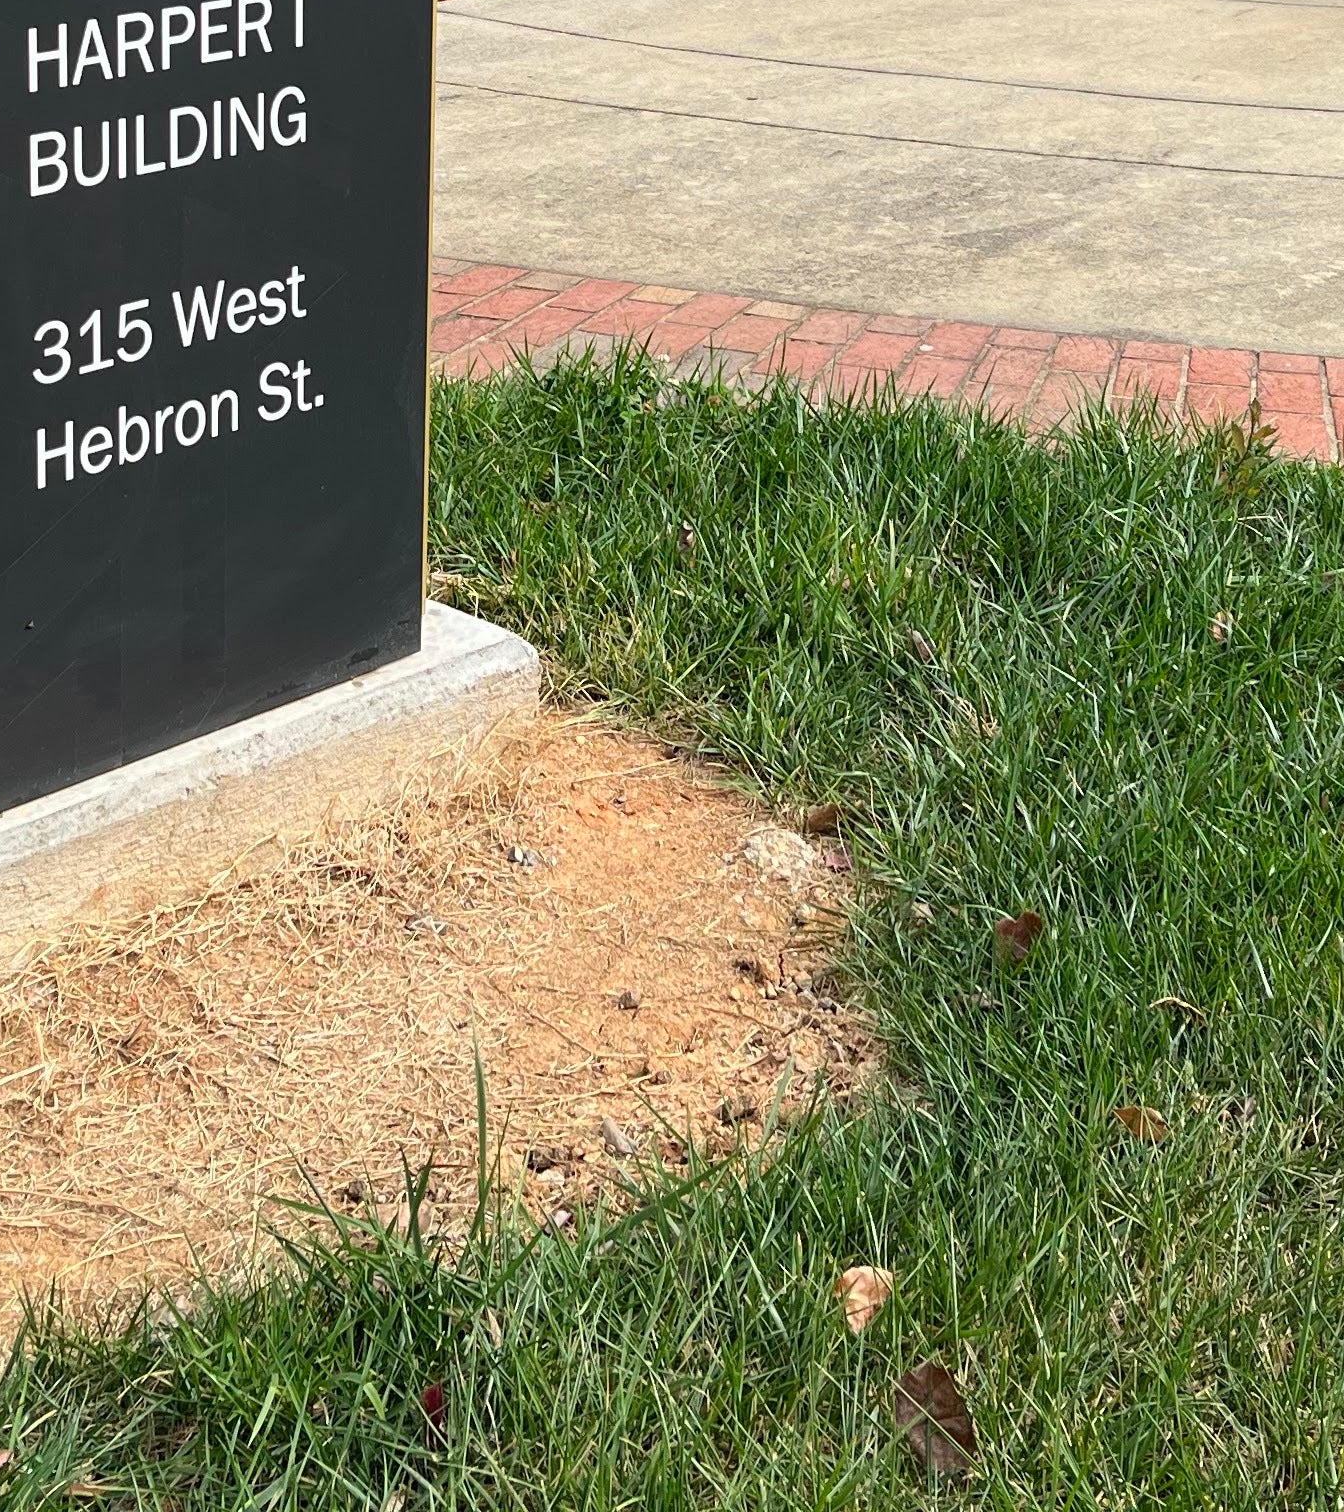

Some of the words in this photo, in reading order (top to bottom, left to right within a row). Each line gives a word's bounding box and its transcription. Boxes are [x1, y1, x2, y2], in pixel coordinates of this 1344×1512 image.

[29, 85, 308, 197] BUILDING
[32, 298, 153, 385] 315
[171, 265, 308, 348] West
[36, 389, 239, 490] Hebron
[257, 359, 325, 422] St.
